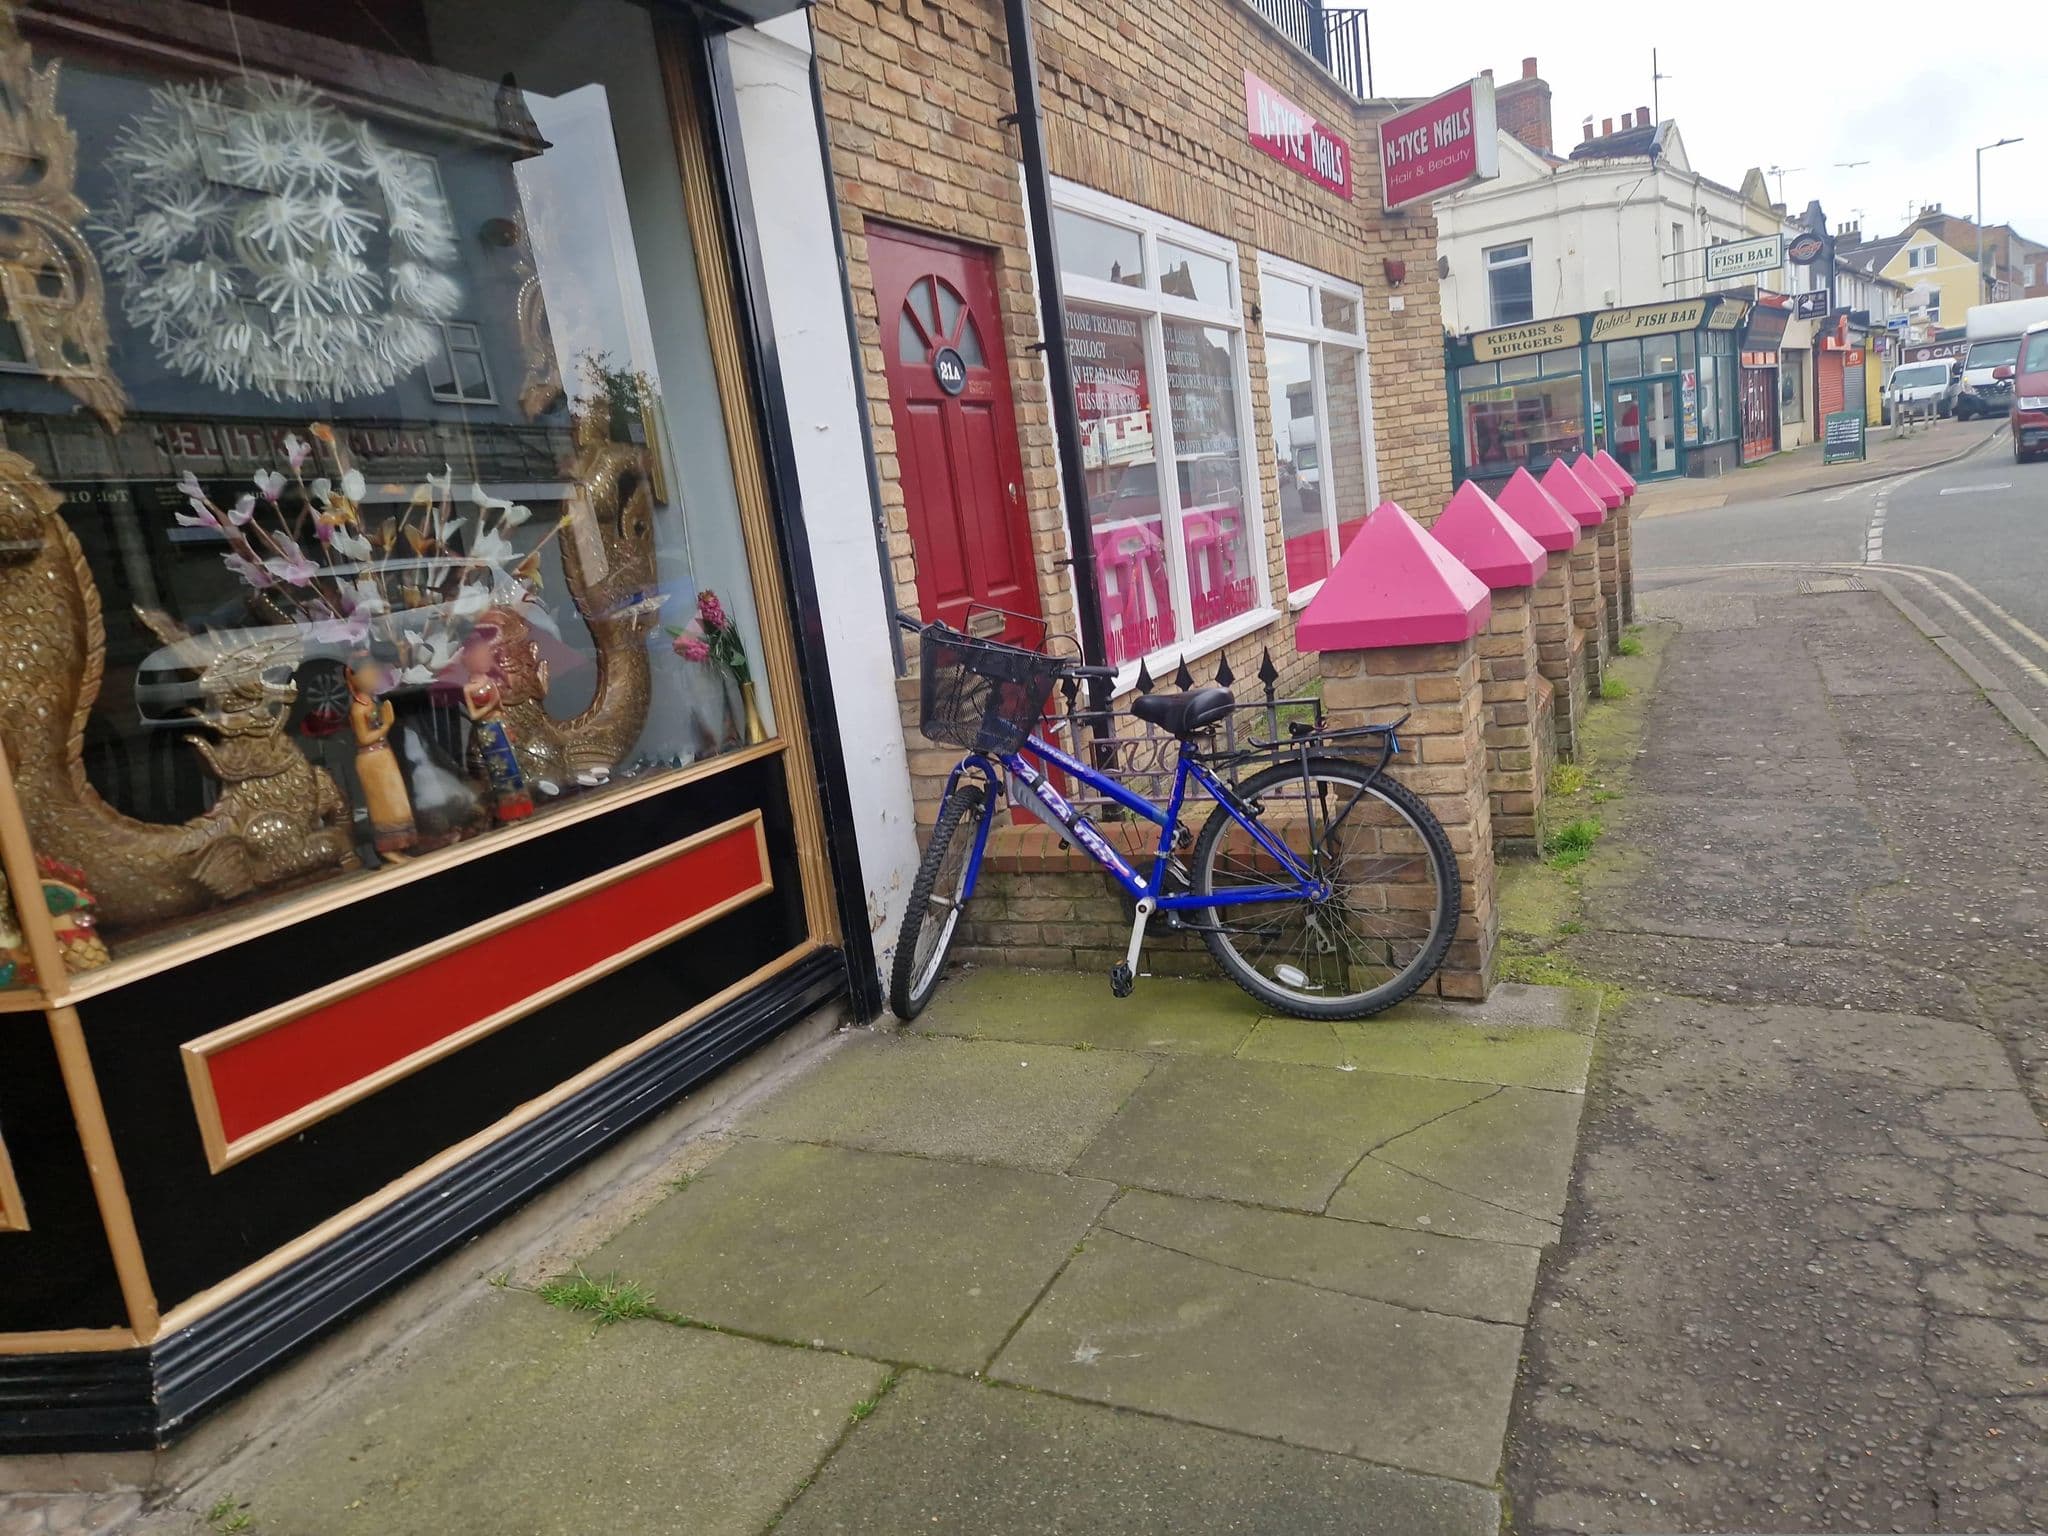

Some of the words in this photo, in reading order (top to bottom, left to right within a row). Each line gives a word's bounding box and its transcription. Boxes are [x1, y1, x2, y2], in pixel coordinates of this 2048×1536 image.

[1257, 88, 1306, 163] N-TYCE
[1311, 127, 1345, 187] NAILS
[1386, 126, 1428, 168] N-TYCE
[1433, 108, 1471, 149] NAILS
[1390, 171, 1412, 187] Hair
[1415, 165, 1425, 177] &
[1428, 147, 1471, 173] Beauty
[1714, 252, 1744, 268] FISH
[1747, 247, 1774, 261] BAR
[1091, 316, 1136, 337] TREATMENT
[1635, 312, 1667, 328] FISH
[1670, 309, 1698, 323] BAR
[1486, 326, 1547, 345] KEBABS
[1552, 323, 1565, 333] &
[1069, 338, 1106, 359] EXOLOGY
[1492, 334, 1564, 356] BURGERS
[1933, 344, 1968, 358] CAFE
[1082, 365, 1106, 385] HEAD
[1106, 368, 1141, 386] MASSAGE
[1078, 392, 1106, 410] TISSUE
